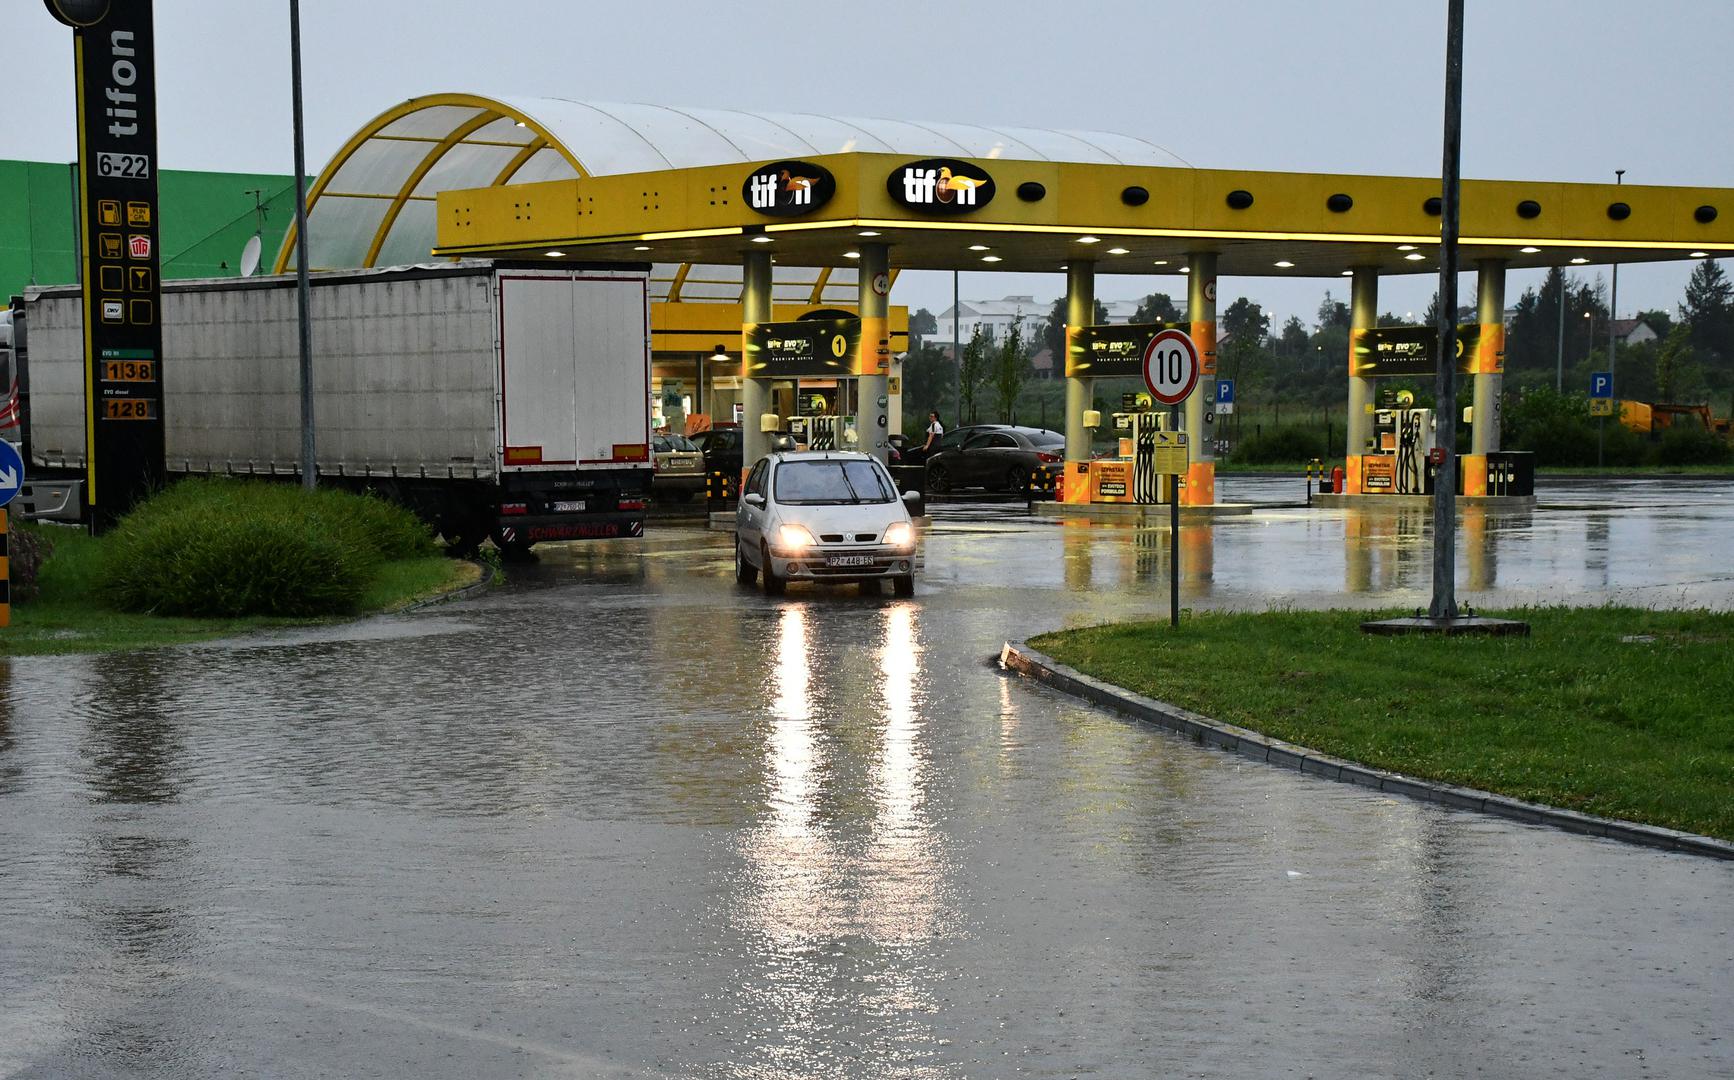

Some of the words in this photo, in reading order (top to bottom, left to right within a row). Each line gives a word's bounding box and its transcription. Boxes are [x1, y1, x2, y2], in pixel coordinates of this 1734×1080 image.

[106, 30, 138, 138] tifon
[99, 154, 148, 178] 6-22
[836, 338, 842, 353] 1
[1157, 350, 1183, 385] 10
[1220, 384, 1229, 398] P
[1596, 377, 1607, 393] P
[109, 402, 147, 417] 128
